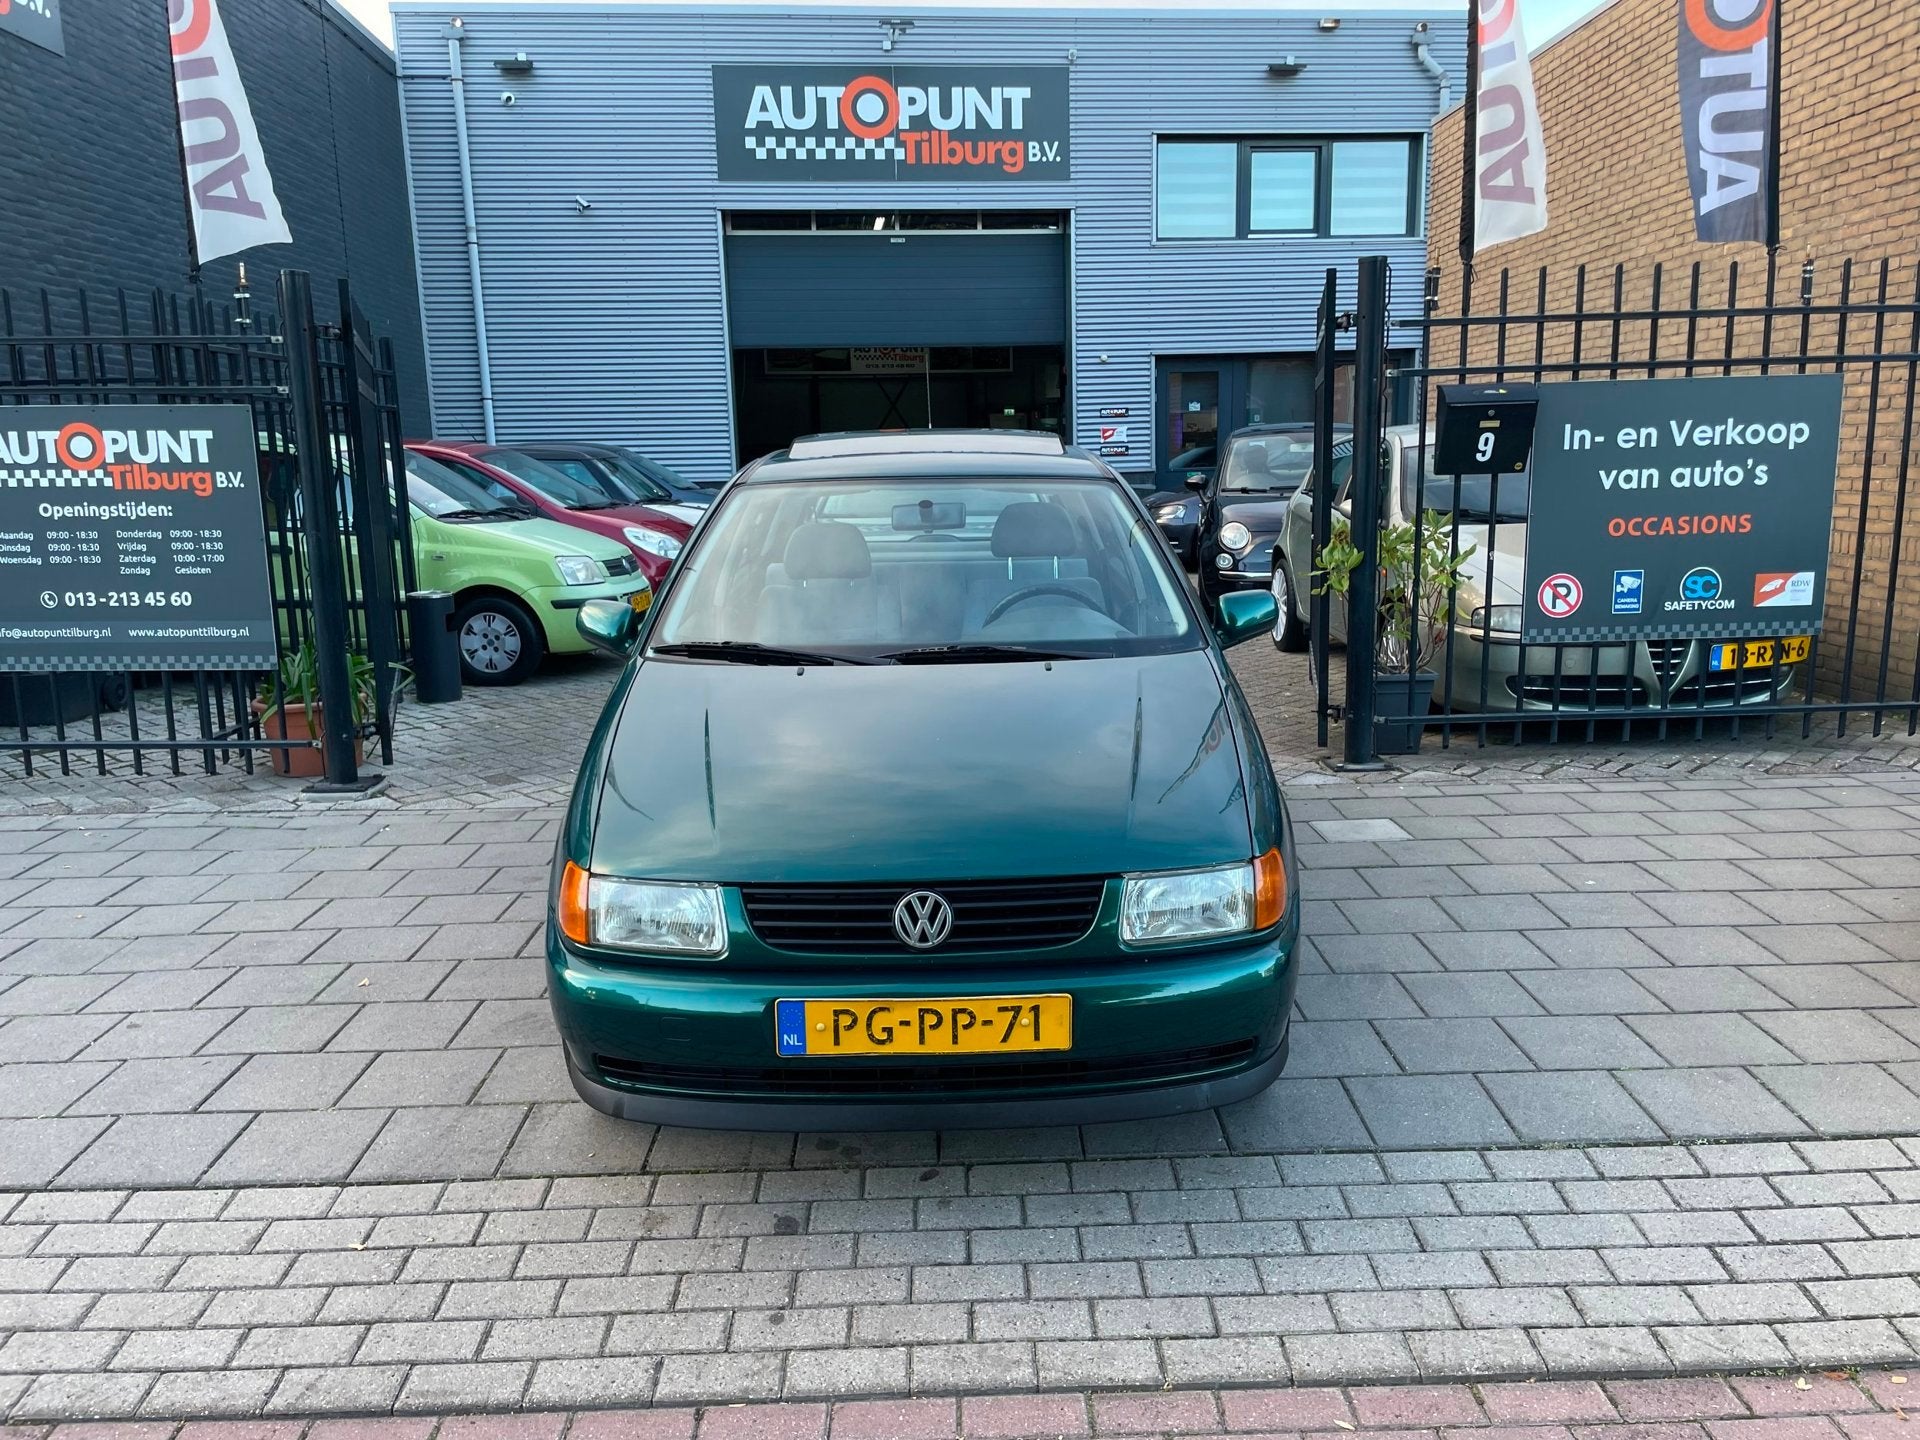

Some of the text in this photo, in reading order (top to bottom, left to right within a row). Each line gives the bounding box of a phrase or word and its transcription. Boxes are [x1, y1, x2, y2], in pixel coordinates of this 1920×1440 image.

[745, 76, 1031, 139] AUTOPUNT
[900, 130, 1061, 173] Tilburg B.V.
[893, 353, 924, 363] Tilburg
[1563, 418, 1810, 450] In- en Verkoop
[1475, 432, 1495, 462] 9
[106, 464, 245, 497] Tilburg B.V.
[1599, 468, 1659, 490] van
[38, 502, 173, 520] Openingstijden:
[1607, 514, 1752, 537] OCCASIONS
[46, 531, 70, 539] 09:00
[76, 531, 98, 539] 18:30
[116, 530, 162, 540] Donderdag
[170, 530, 192, 538] 09:00
[200, 530, 222, 538] 18:30
[48, 543, 70, 552] 09:00
[78, 543, 100, 552] 18:30
[117, 542, 147, 552] Vrijdag
[171, 542, 194, 550] 09:00
[201, 542, 224, 550] 18:30
[0, 556, 42, 566] Woensdag
[50, 556, 72, 564] 09:00
[79, 556, 102, 564] 18:30
[119, 554, 156, 564] Zaterdag
[173, 554, 196, 562] 10:00
[202, 554, 225, 562] 17:00
[120, 566, 212, 576] Zondag Gesloten
[1684, 575, 1718, 599] SC
[1790, 579, 1811, 588] RDW
[144, 591, 166, 607] 45
[170, 591, 192, 607] 60
[1664, 600, 1735, 611] SAFETYCOM
[128, 626, 250, 638] www.autopunttilburg.nl
[832, 1004, 1042, 1046] PG-PP-71
[783, 1034, 803, 1046] NL
